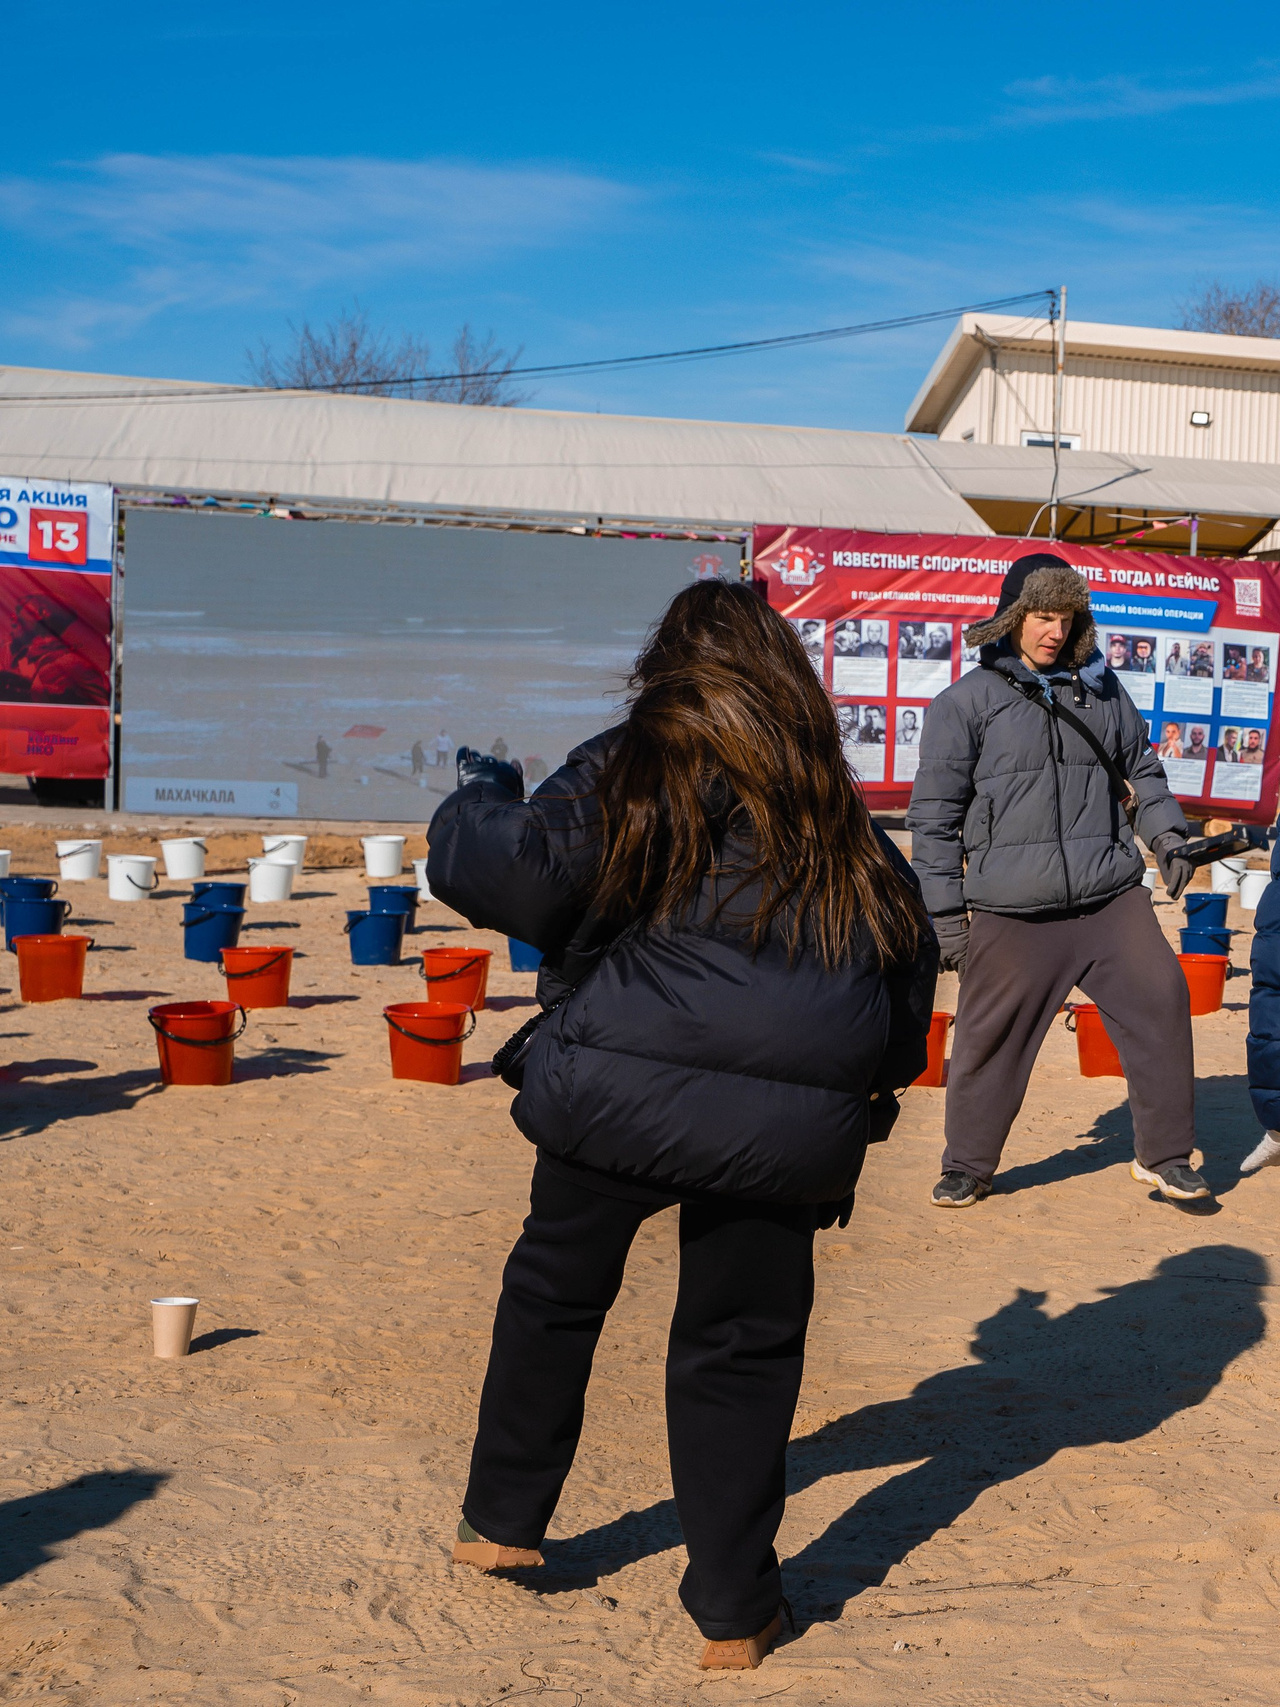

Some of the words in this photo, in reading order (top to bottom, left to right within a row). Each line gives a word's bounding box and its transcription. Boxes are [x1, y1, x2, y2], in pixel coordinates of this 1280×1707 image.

[17, 490, 88, 508] АКЦИЯ
[37, 520, 79, 552] 13
[832, 550, 919, 570] ИЗВЕСТНЫЕ
[1108, 568, 1153, 588] ТОГДА
[1154, 572, 1166, 587] И
[1167, 571, 1221, 592] СЕЙЧАС
[851, 590, 857, 600] В
[859, 591, 881, 602] ГОДЫ
[882, 590, 921, 602] ВЕЛИКОЙ
[922, 592, 987, 605] ОТЕЧЕСТВЕННОЙ
[1127, 605, 1164, 617] ВОЕННОЙ
[1164, 608, 1204, 621] ОПЕРАЦИИ
[155, 788, 235, 804] МАХАЧКАЛА
